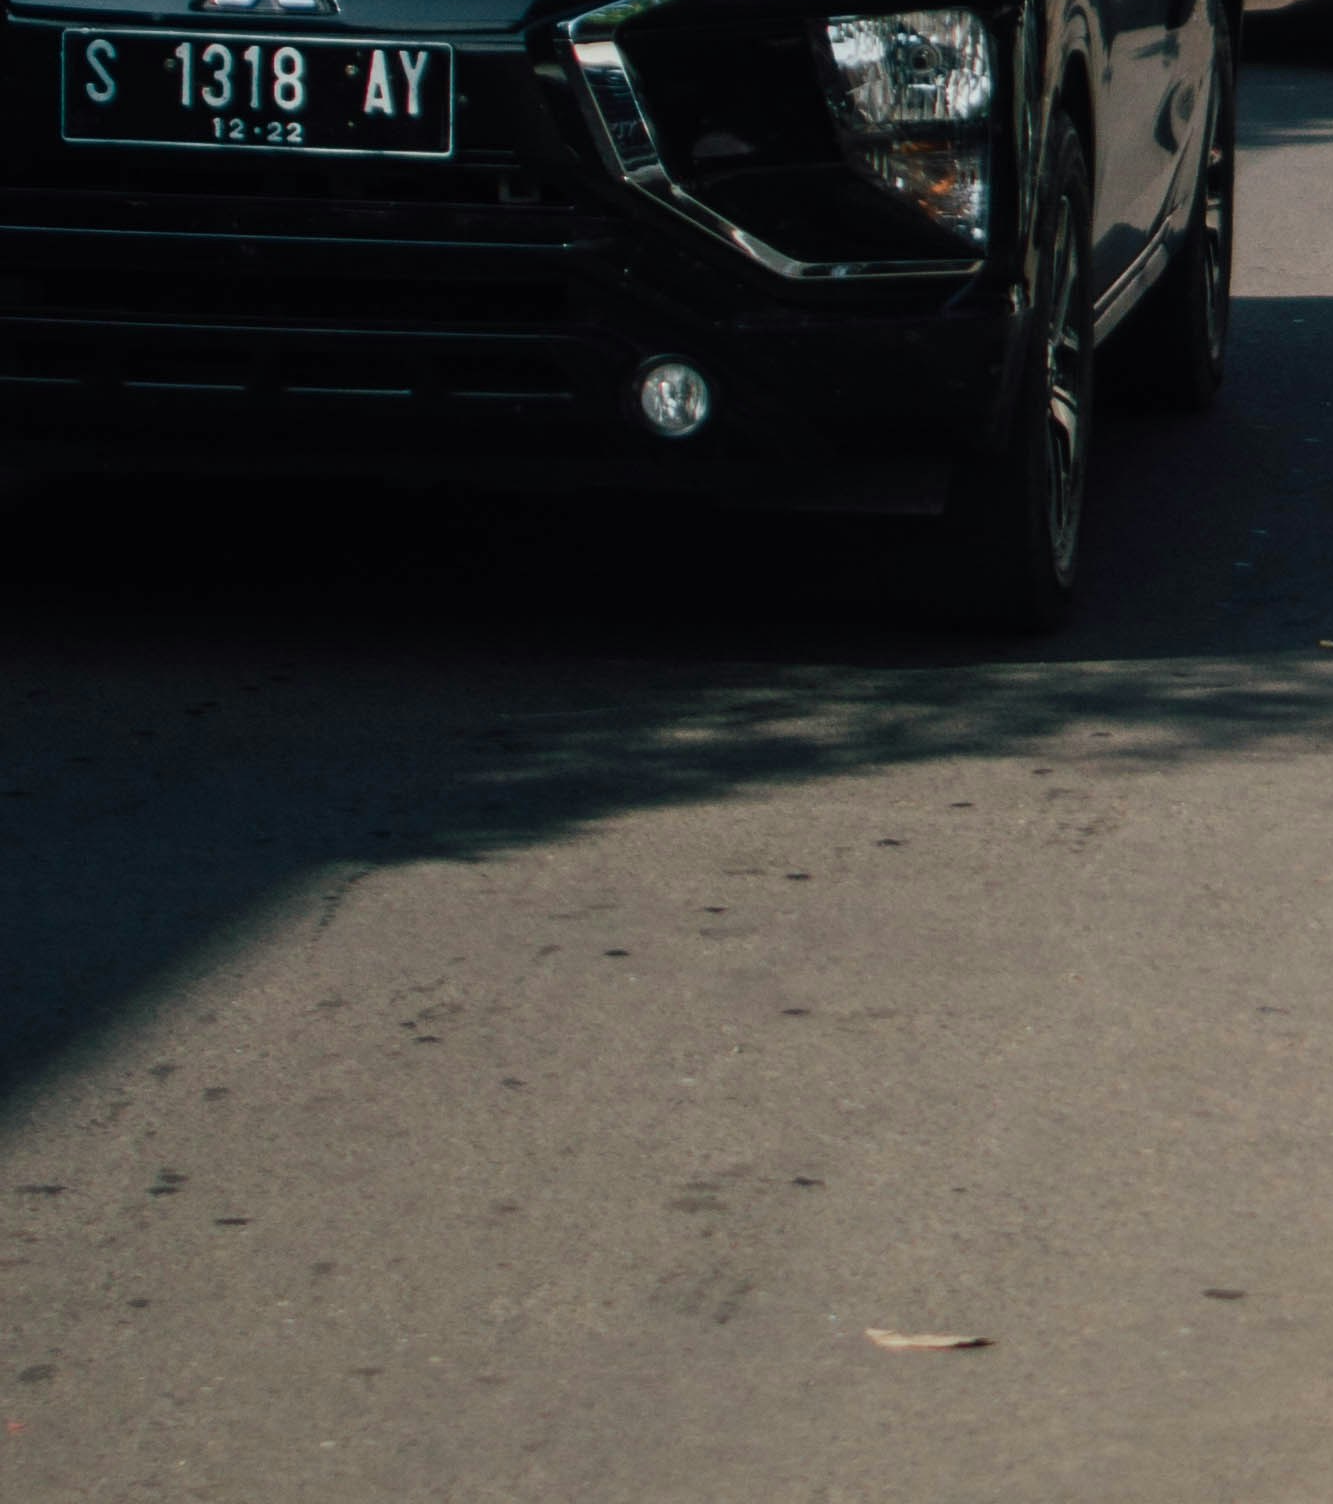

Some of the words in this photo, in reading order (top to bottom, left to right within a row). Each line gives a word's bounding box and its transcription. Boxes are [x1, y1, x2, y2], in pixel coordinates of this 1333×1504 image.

[85, 38, 117, 103] S
[173, 41, 306, 112] 1318
[363, 49, 429, 117] AY
